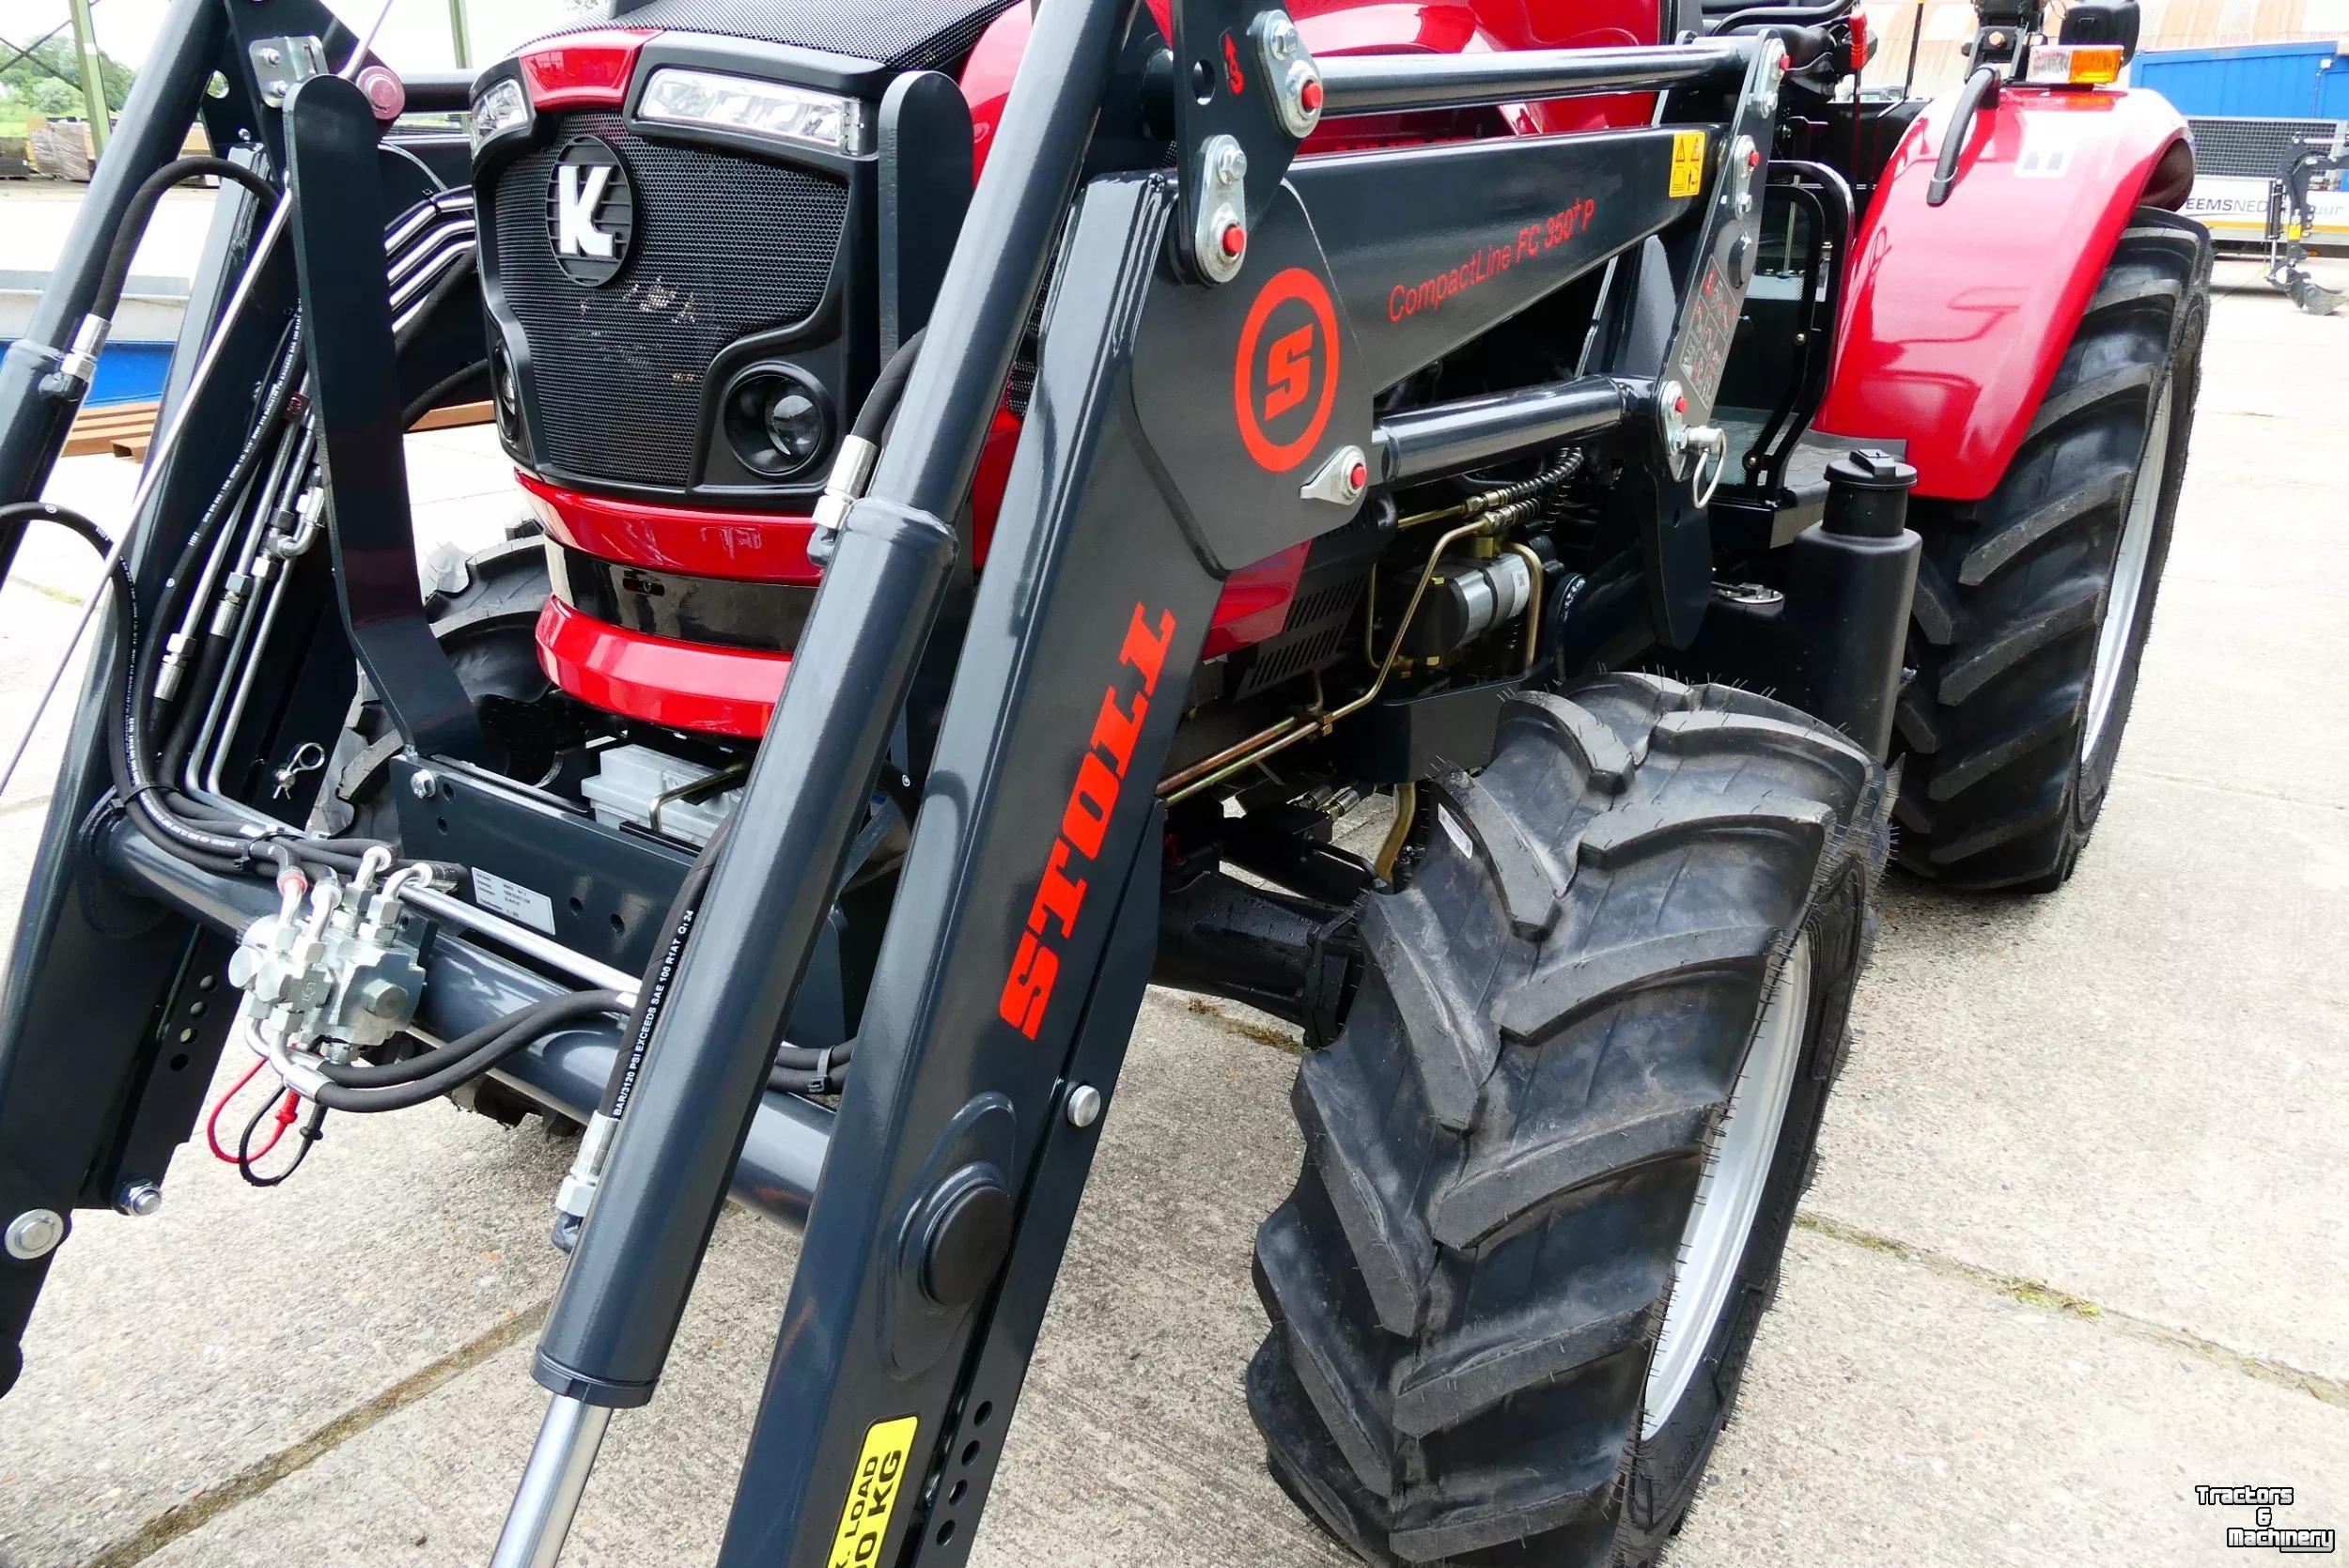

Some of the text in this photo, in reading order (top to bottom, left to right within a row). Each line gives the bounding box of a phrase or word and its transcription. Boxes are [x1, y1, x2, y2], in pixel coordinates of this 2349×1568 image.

[558, 164, 614, 257] K
[1388, 244, 1512, 323] CompactLine
[1516, 224, 1541, 264] FC
[1264, 323, 1314, 422] S
[999, 601, 1176, 1041] STOLL
[659, 966, 671, 983] 100
[665, 938, 681, 965] R1AT
[650, 984, 665, 1005] SAE
[634, 1007, 657, 1052] EXCEEDS
[629, 1053, 641, 1070] PSI
[613, 1071, 636, 1117] BAR/3120
[844, 1456, 879, 1538] LOAD
[867, 1450, 902, 1517] KG
